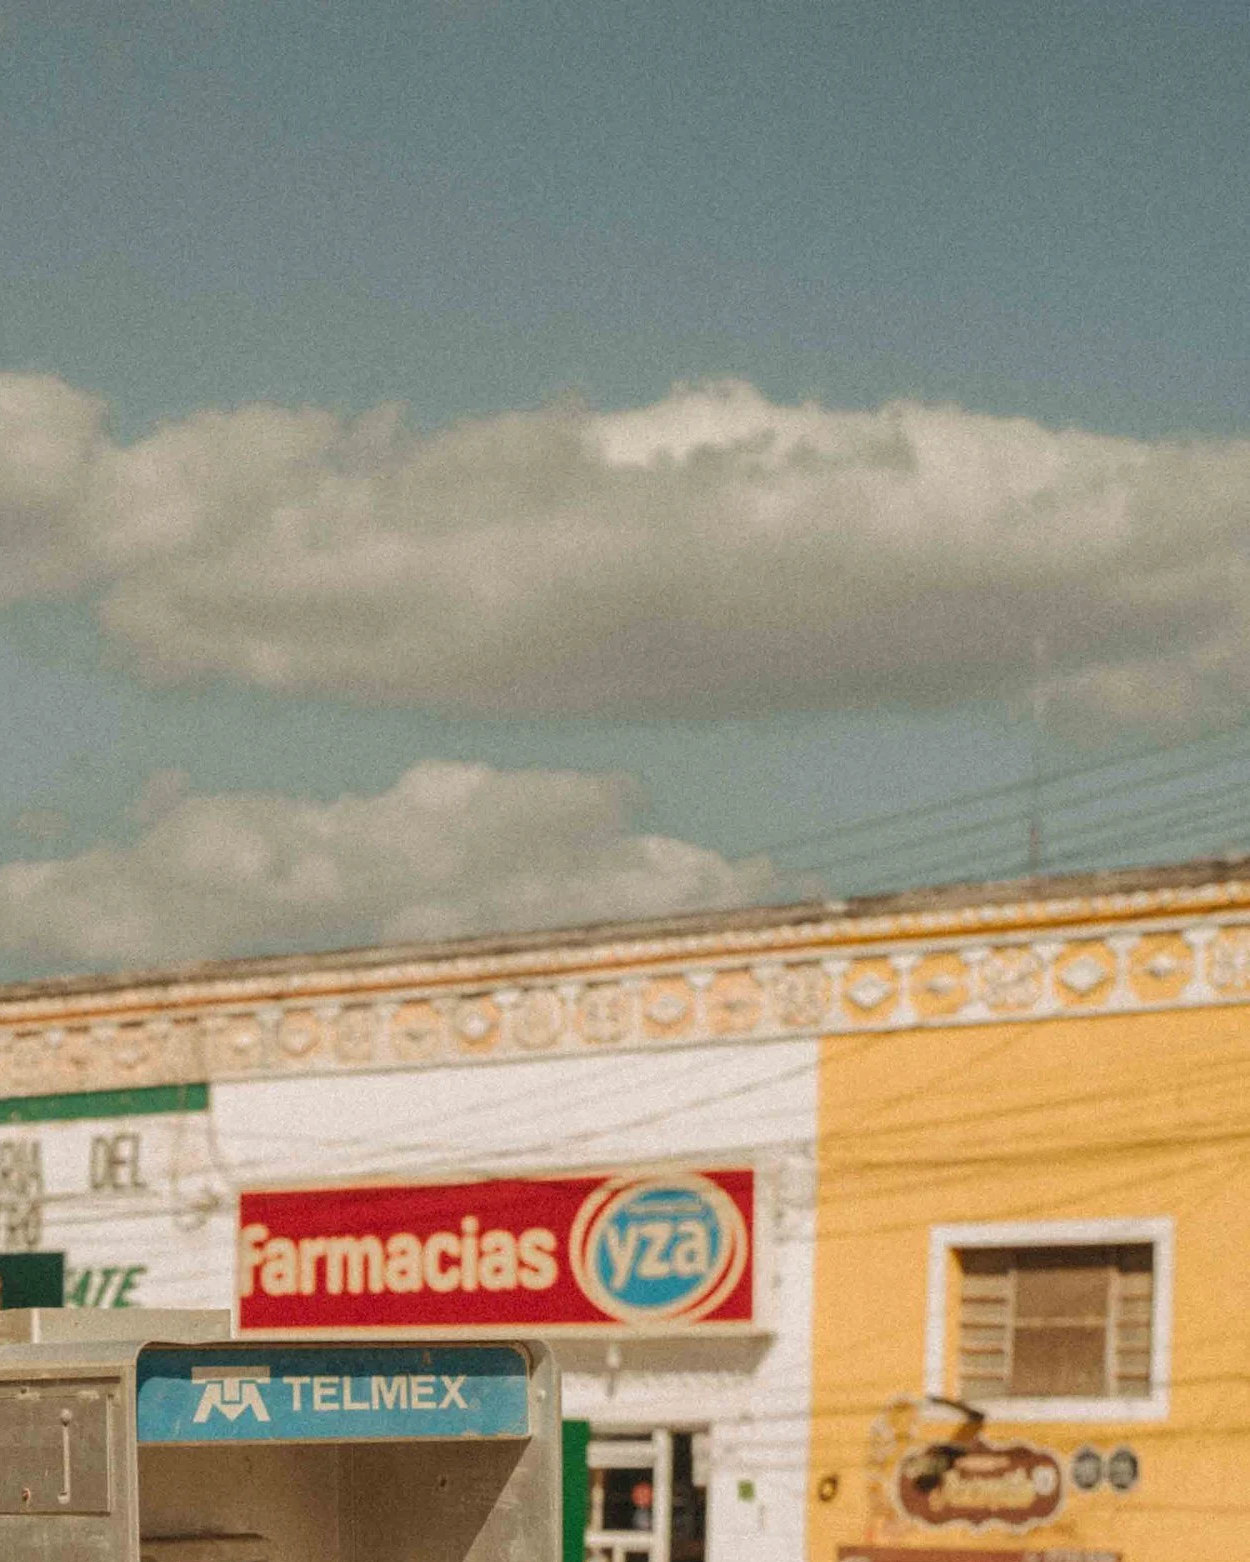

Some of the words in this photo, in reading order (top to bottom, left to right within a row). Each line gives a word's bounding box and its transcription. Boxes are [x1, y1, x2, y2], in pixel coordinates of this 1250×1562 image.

[89, 1131, 145, 1190] DEL
[241, 1216, 557, 1296] farmacias
[606, 1219, 709, 1290] yza
[283, 1374, 469, 1412] TELMEX
